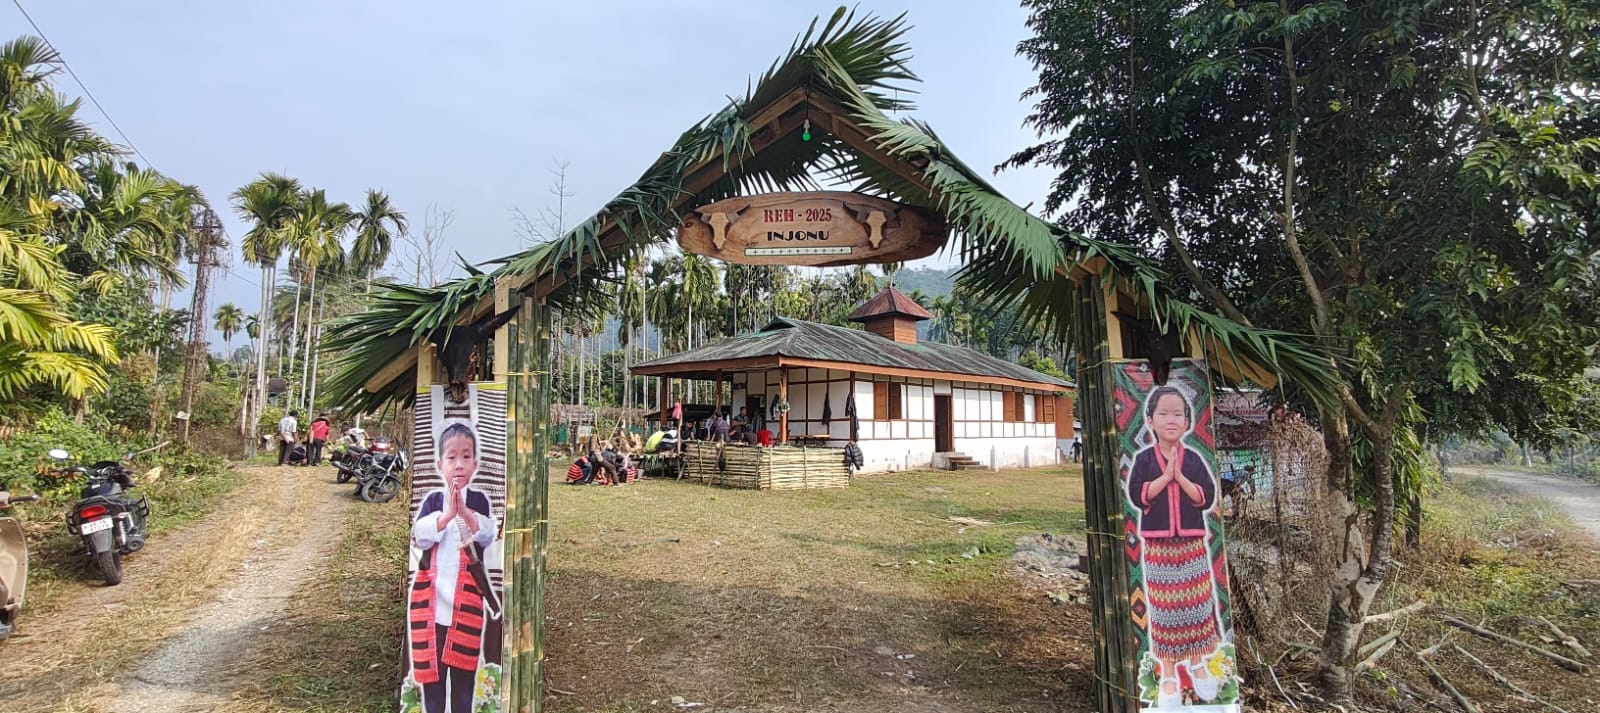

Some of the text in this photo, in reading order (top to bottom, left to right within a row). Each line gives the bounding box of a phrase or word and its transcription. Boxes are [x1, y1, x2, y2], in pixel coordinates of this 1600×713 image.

[763, 209, 794, 223] REH
[806, 208, 832, 222] 2025
[767, 230, 830, 241] INJONU
